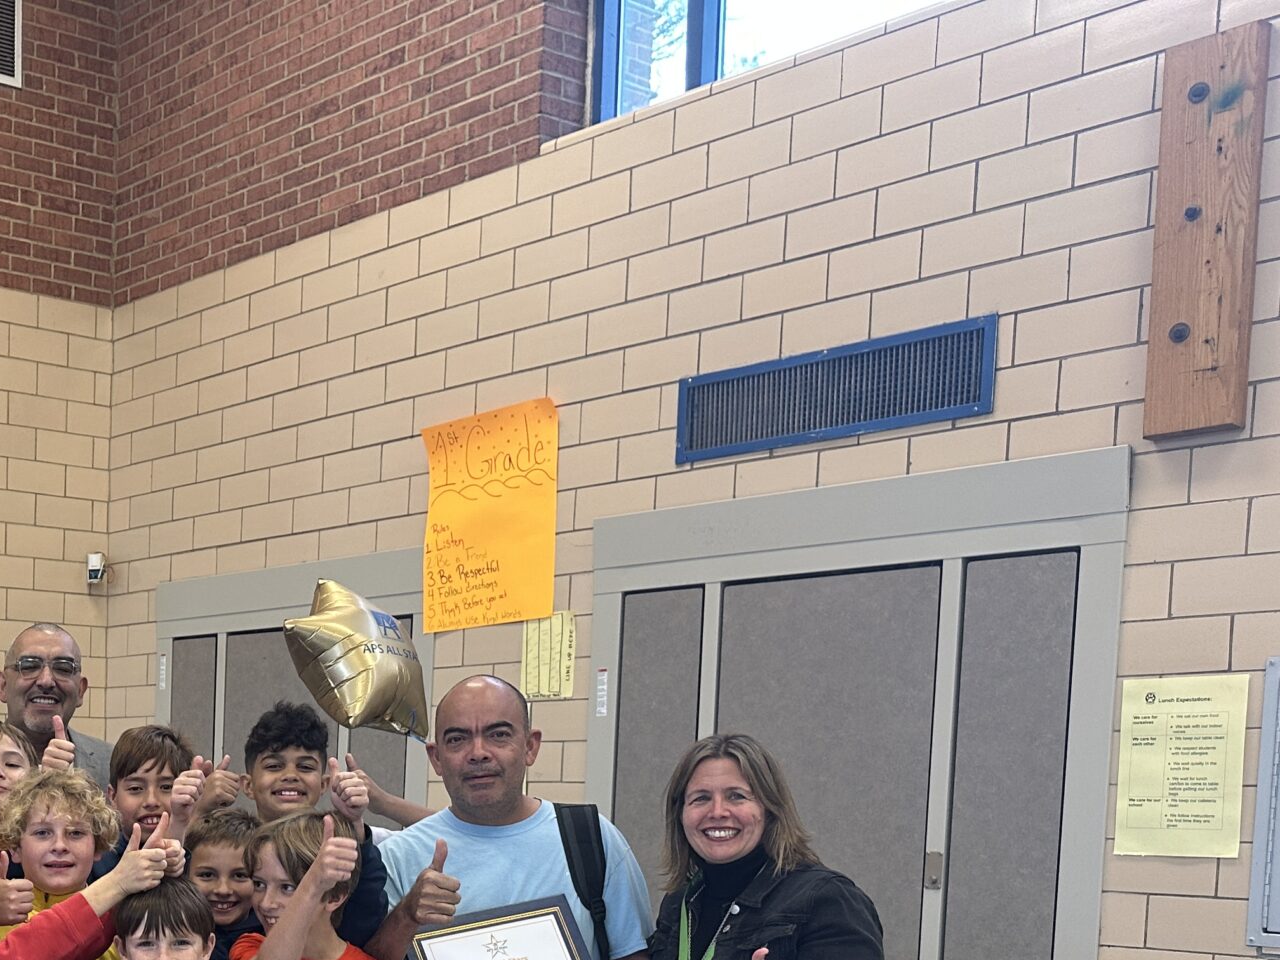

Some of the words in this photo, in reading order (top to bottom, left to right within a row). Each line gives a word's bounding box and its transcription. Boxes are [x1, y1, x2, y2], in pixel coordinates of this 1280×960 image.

[465, 414, 546, 480] Grade
[435, 531, 465, 552] Listen
[427, 571, 436, 587] 3
[438, 569, 453, 585] Be
[456, 560, 500, 583] Respectful
[428, 589, 435, 601] 4
[428, 604, 436, 619] 5
[363, 644, 384, 655] APS
[386, 645, 403, 657] ALL
